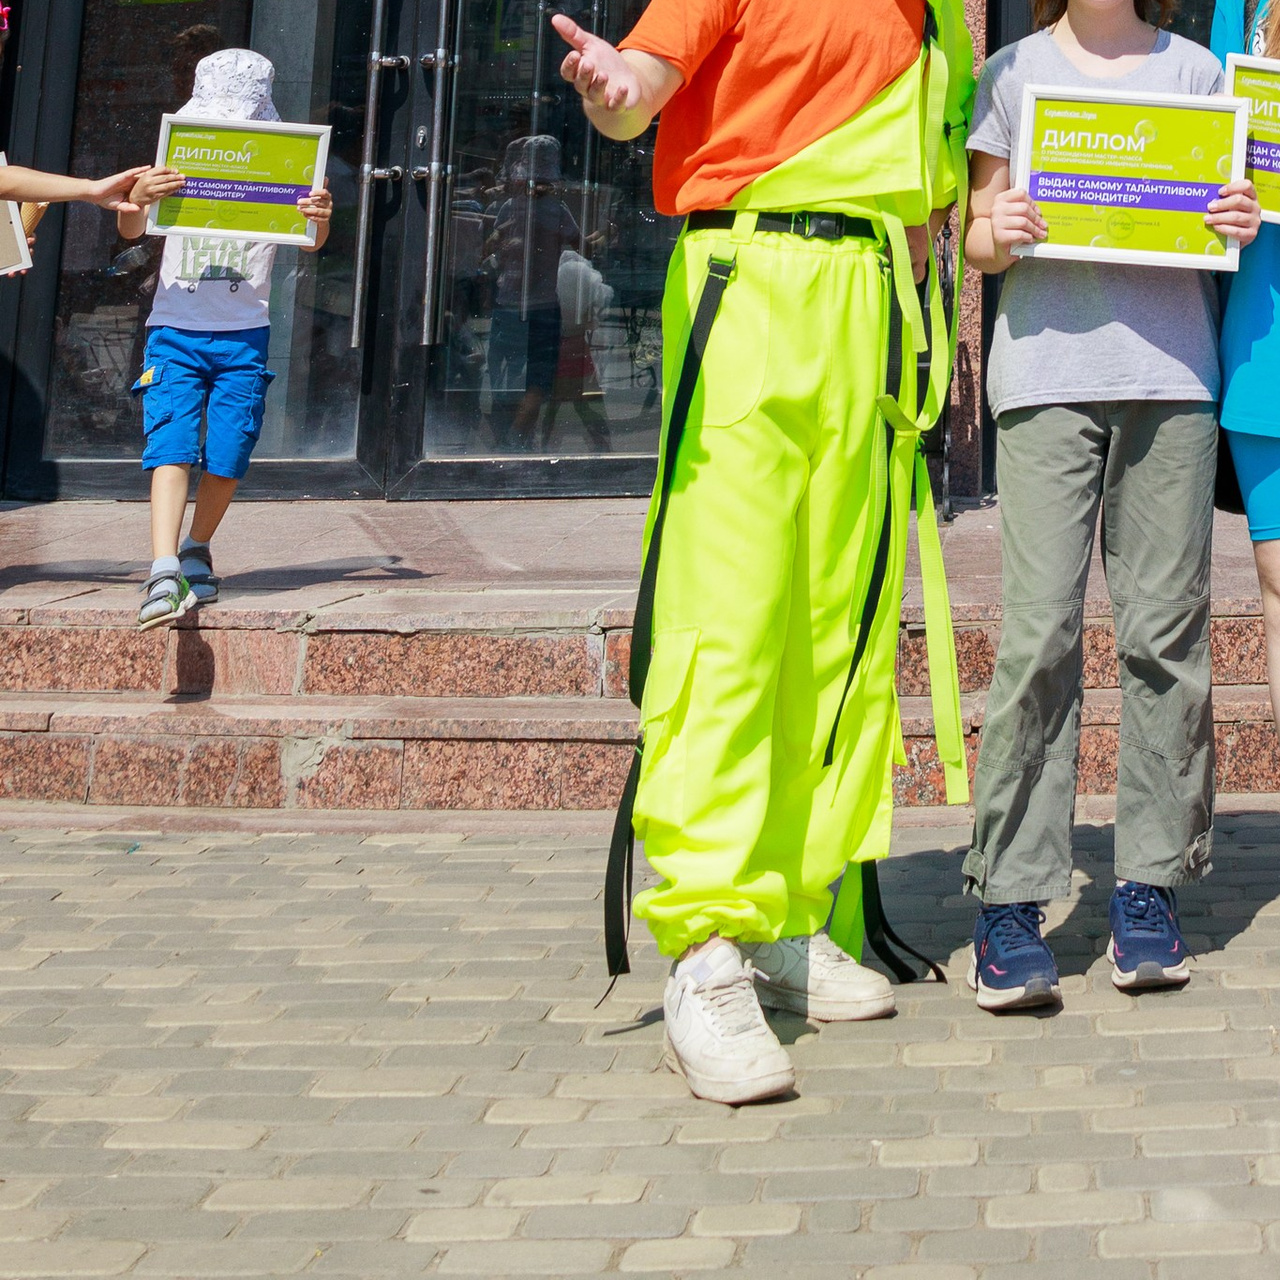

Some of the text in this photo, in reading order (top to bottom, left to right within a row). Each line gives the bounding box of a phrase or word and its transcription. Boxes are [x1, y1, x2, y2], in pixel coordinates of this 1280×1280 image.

[1041, 129, 1146, 153] ДИПЛОМ
[172, 146, 251, 163] ДИПЛОМ
[200, 190, 246, 199] КОНДИТЕРУ
[234, 184, 296, 195] ТАЛАНТЛИВОМУ
[1038, 176, 1208, 198] ВЫДАН САМОМУ ТАЛАНТЛИВОМУ
[1037, 188, 1141, 204] ЮНОМУ КОНДИТЕРУ
[181, 251, 253, 280] LEVEL
